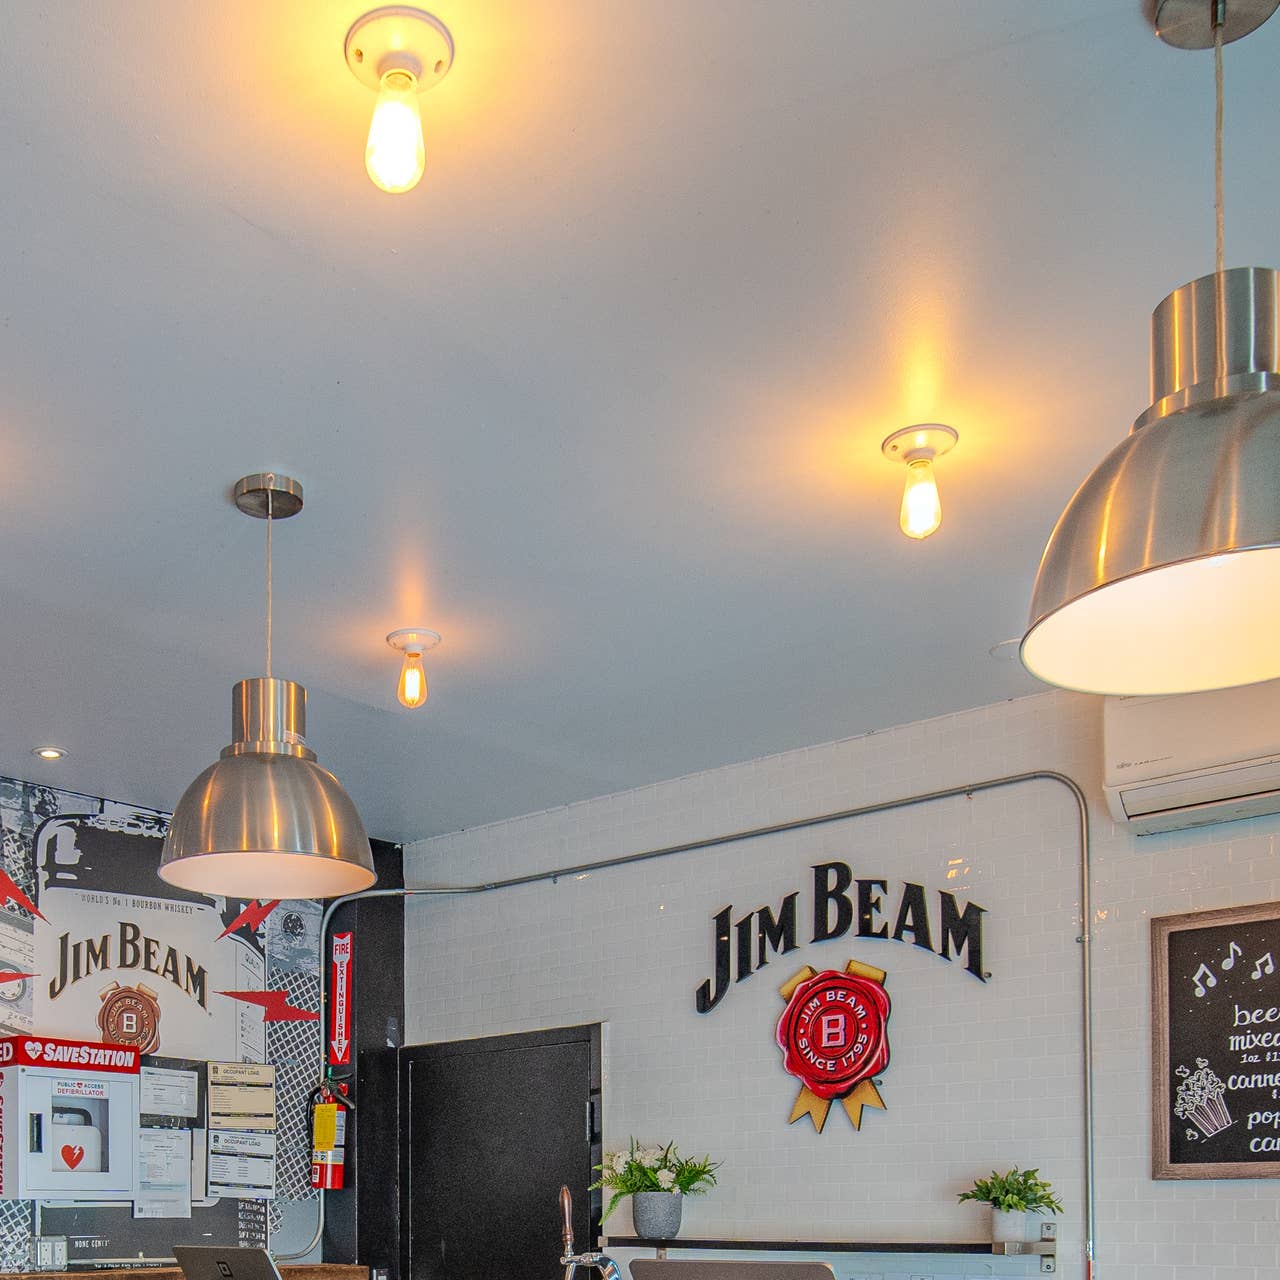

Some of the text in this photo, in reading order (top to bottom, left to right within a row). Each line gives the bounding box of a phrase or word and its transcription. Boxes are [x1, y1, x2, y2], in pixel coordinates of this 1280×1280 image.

[165, 903, 193, 914] WHISKEY
[696, 861, 988, 1014] JIM BEAM
[335, 943, 349, 955] FIRE
[48, 921, 208, 1010] JIM BEAM
[801, 991, 866, 1023] JIM BEAM
[123, 1013, 137, 1032] B
[822, 1014, 845, 1047] B
[800, 1034, 867, 1070] SINCE 1795
[223, 1068, 247, 1076] OCCUPANT
[58, 1088, 104, 1096] DEFIBRILLATOR
[224, 1138, 248, 1146] OCCUPANT
